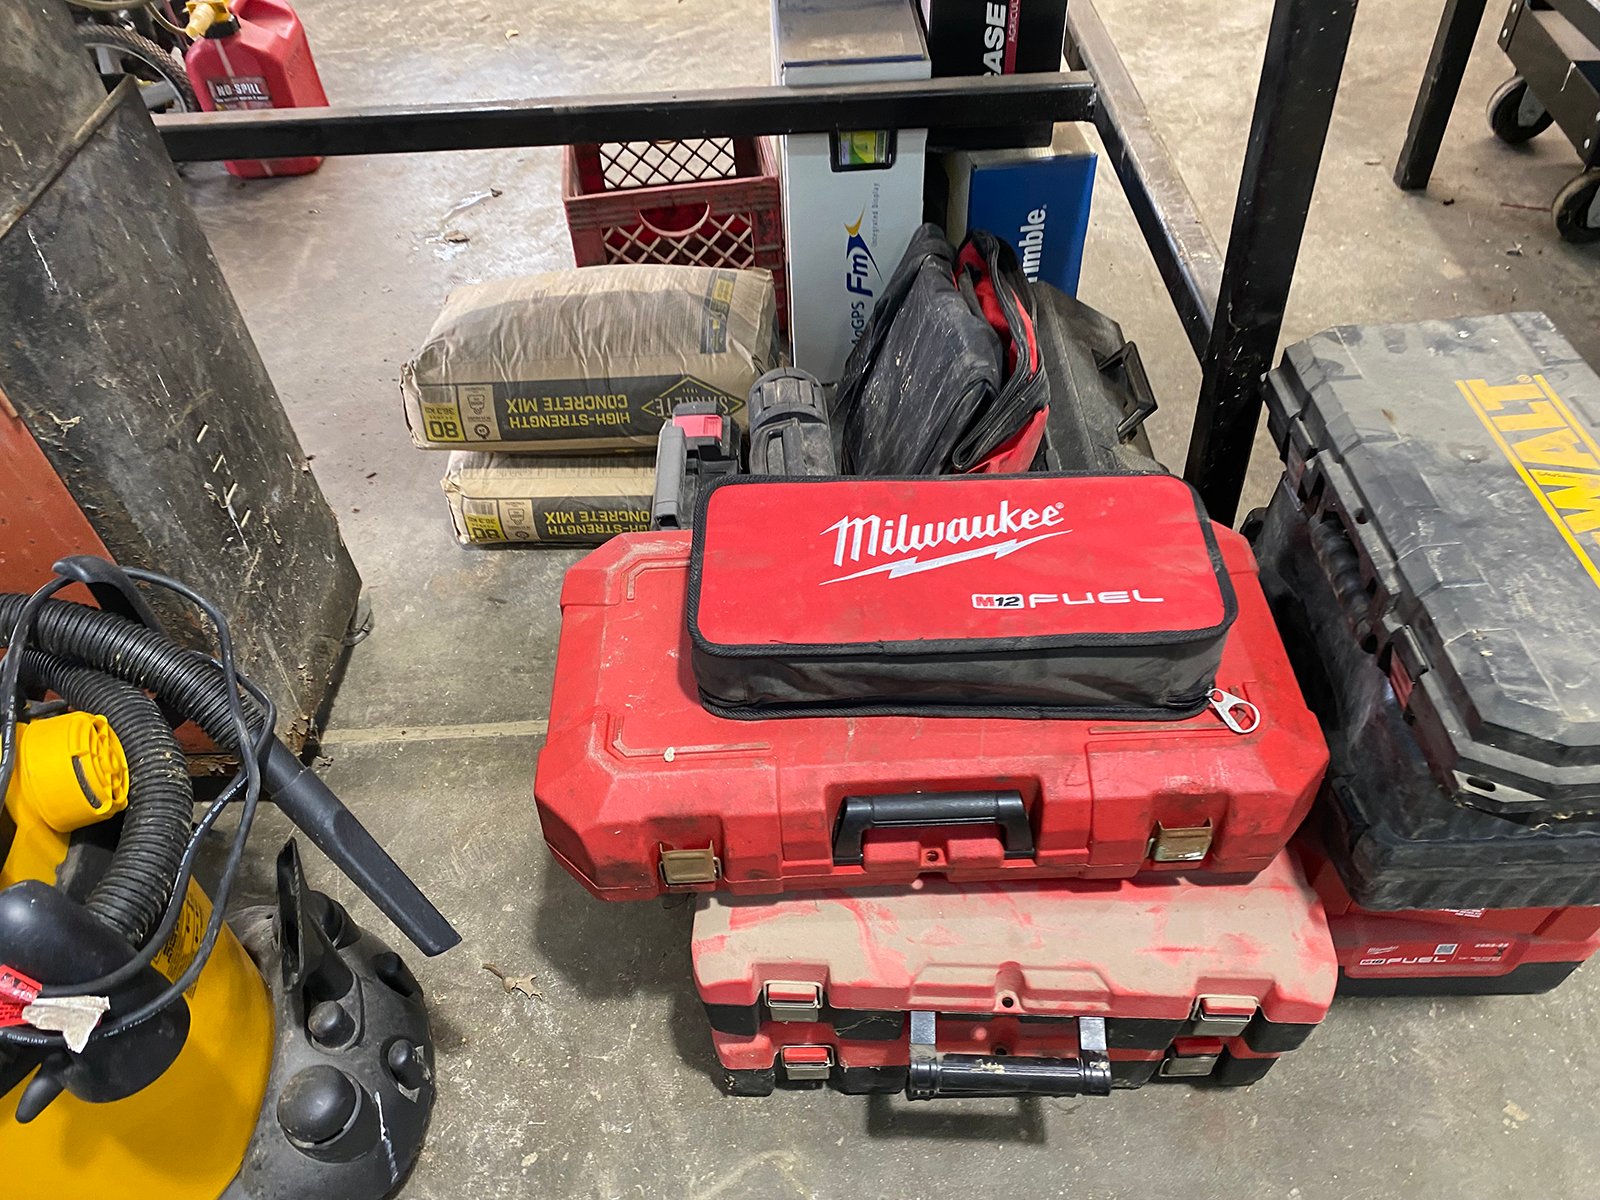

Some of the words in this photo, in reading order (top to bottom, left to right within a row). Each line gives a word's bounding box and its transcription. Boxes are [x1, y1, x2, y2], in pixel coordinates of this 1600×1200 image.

[1008, 0, 1019, 42] AGRICUL
[872, 183, 880, 209] Display
[871, 211, 879, 247] Integrated
[1018, 208, 1047, 283] rimble
[505, 397, 539, 414] MIX
[543, 394, 628, 411] CONCRETE
[509, 411, 631, 429] HIGH-STRENGTH
[429, 421, 458, 438] 80
[543, 511, 575, 524] MIX
[580, 510, 650, 523] ONCRETE
[819, 500, 1065, 567] Milwaukee
[973, 594, 1023, 609] M12
[1030, 589, 1164, 608] FUEL
[1386, 956, 1446, 965] FUEL
[7, 1033, 48, 1045] COMPLIANT
